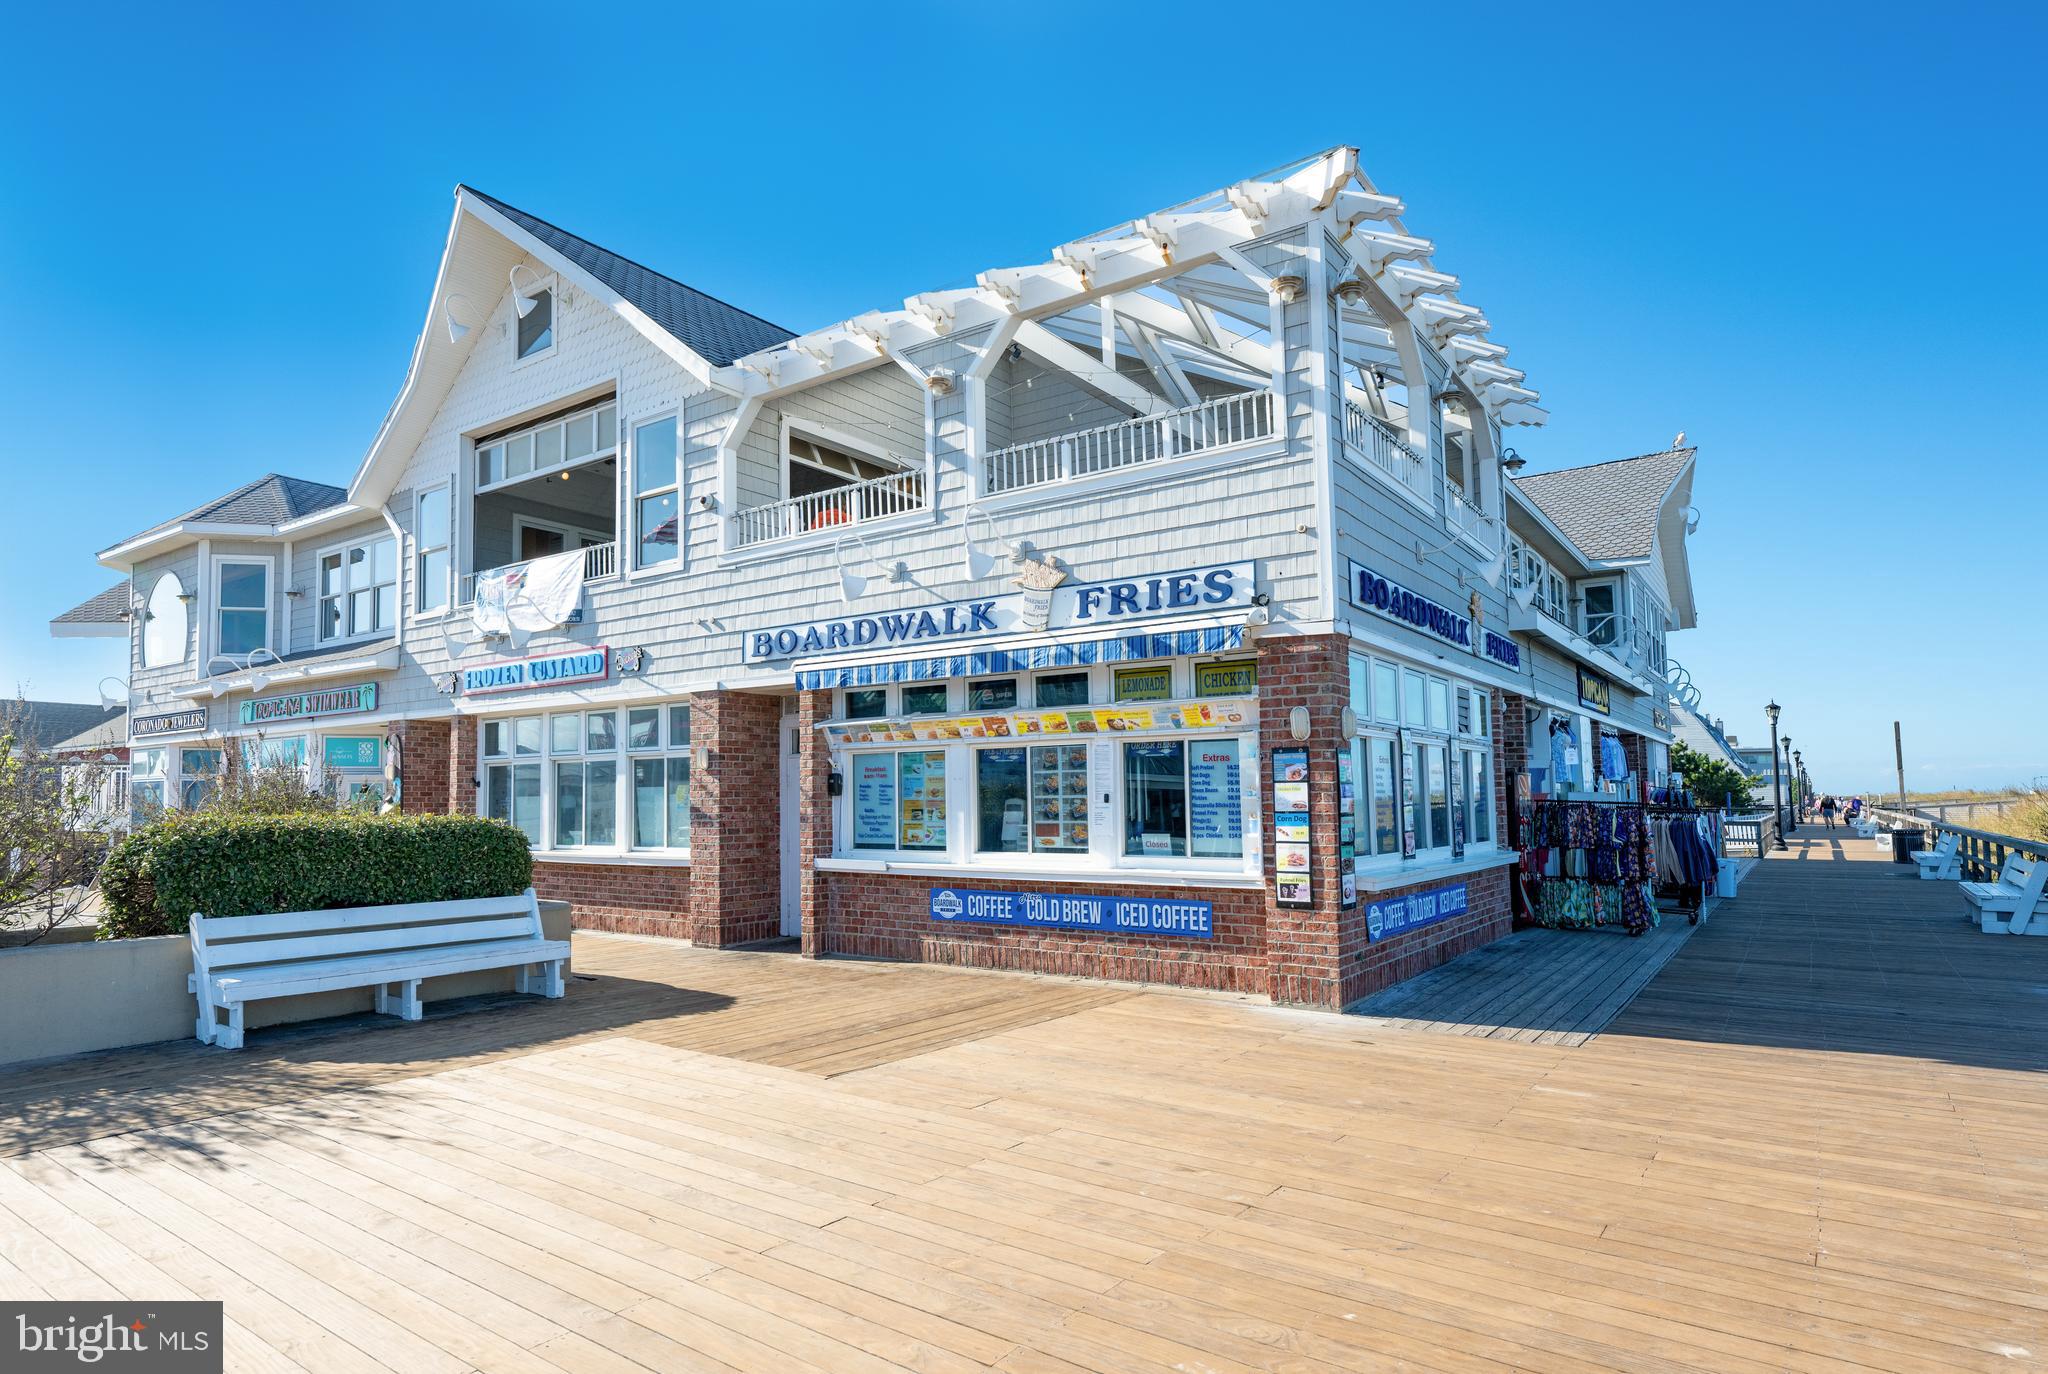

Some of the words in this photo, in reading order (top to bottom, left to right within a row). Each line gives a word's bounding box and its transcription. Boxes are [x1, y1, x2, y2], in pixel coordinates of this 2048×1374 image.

[752, 601, 997, 657] BOARDWALK
[1077, 569, 1233, 619] FRIES
[1359, 570, 1470, 646] BOARDWALK
[1486, 632, 1519, 668] FRIES
[465, 664, 522, 689] FROZEN
[528, 653, 604, 681] CUSTARD
[1203, 670, 1251, 689] CHICKEN
[996, 690, 1013, 698] OPEN
[1122, 676, 1166, 693] LEMONADE
[254, 696, 302, 719] TROPICANA
[305, 690, 360, 713] SWIMWEAR
[171, 712, 204, 729] JEWELERS
[1202, 753, 1231, 762] Extras
[1293, 815, 1308, 823] Dog
[1145, 840, 1169, 848] Closed
[934, 898, 962, 908] BOARDWALK
[968, 895, 1013, 919] COFFEE
[1408, 898, 1424, 923] COLD
[1423, 895, 1437, 919] BREW
[1450, 888, 1466, 911] COFFEE
[1027, 899, 1060, 922] COLD
[1062, 900, 1102, 924] BREW
[1116, 902, 1148, 927] ICED
[1152, 904, 1209, 931] COFFEE
[1384, 902, 1405, 930] COFFEE
